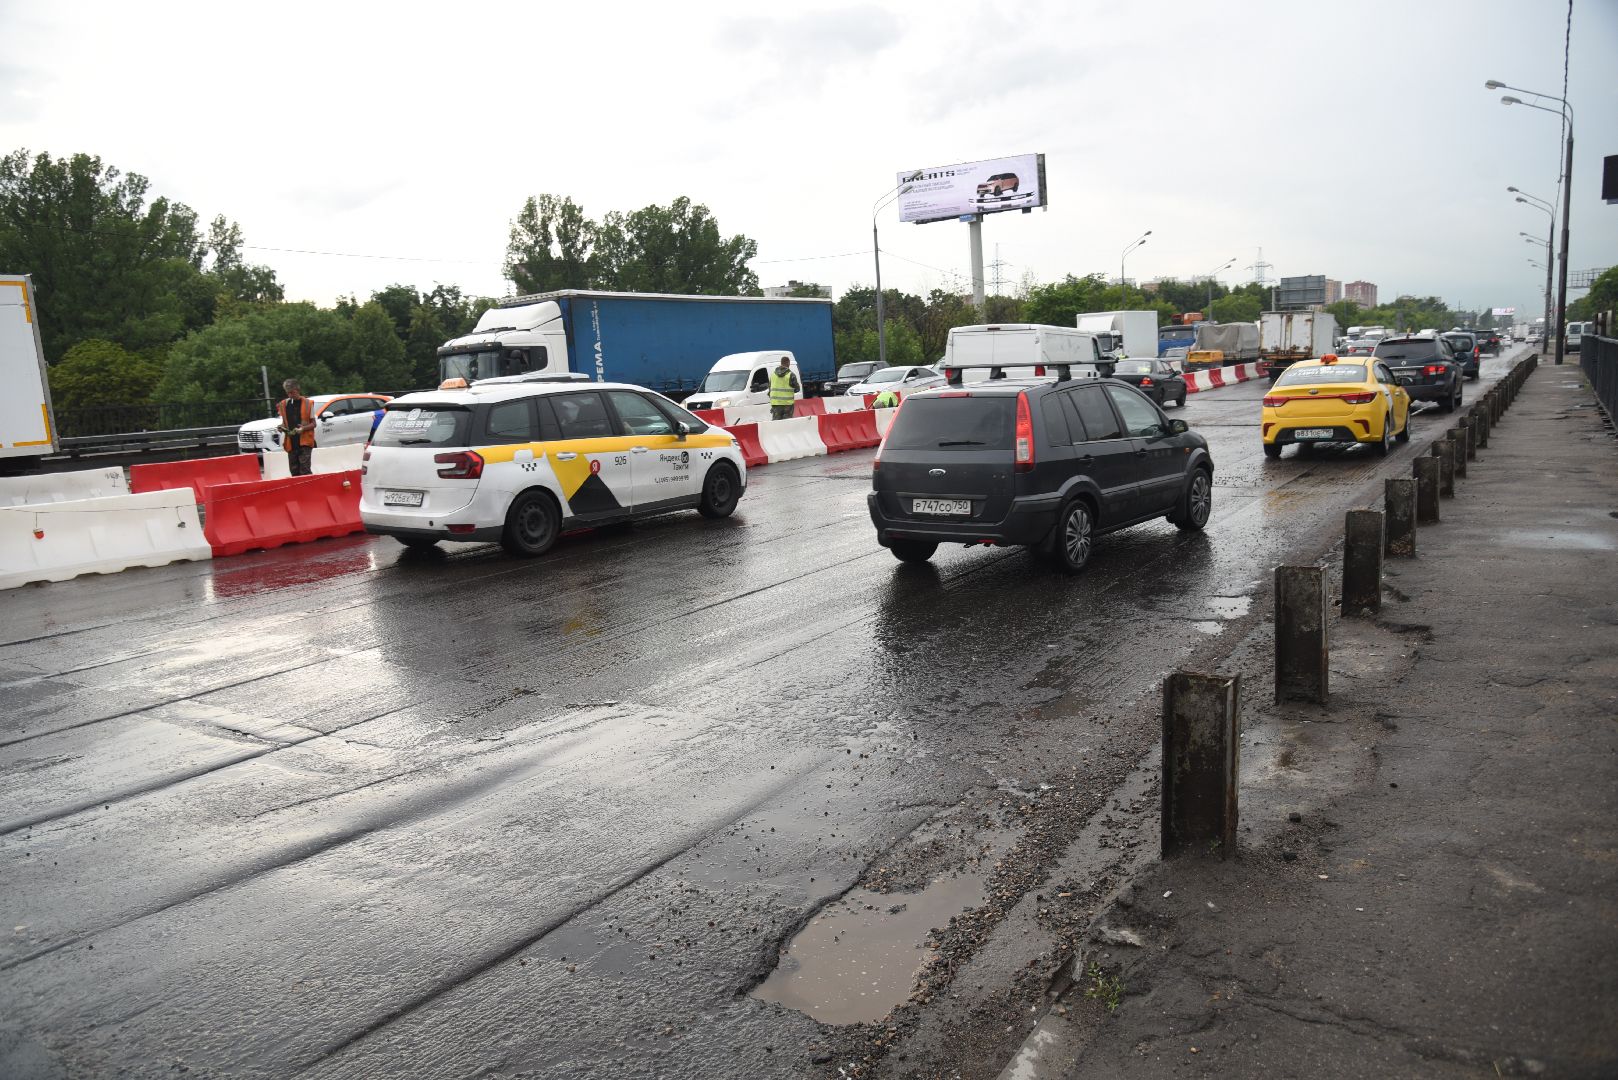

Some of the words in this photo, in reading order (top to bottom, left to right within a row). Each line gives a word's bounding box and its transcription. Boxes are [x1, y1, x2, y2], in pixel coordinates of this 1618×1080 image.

[593, 341, 605, 383] PEMA
[615, 455, 627, 466] 926
[659, 453, 681, 463] Яндекс
